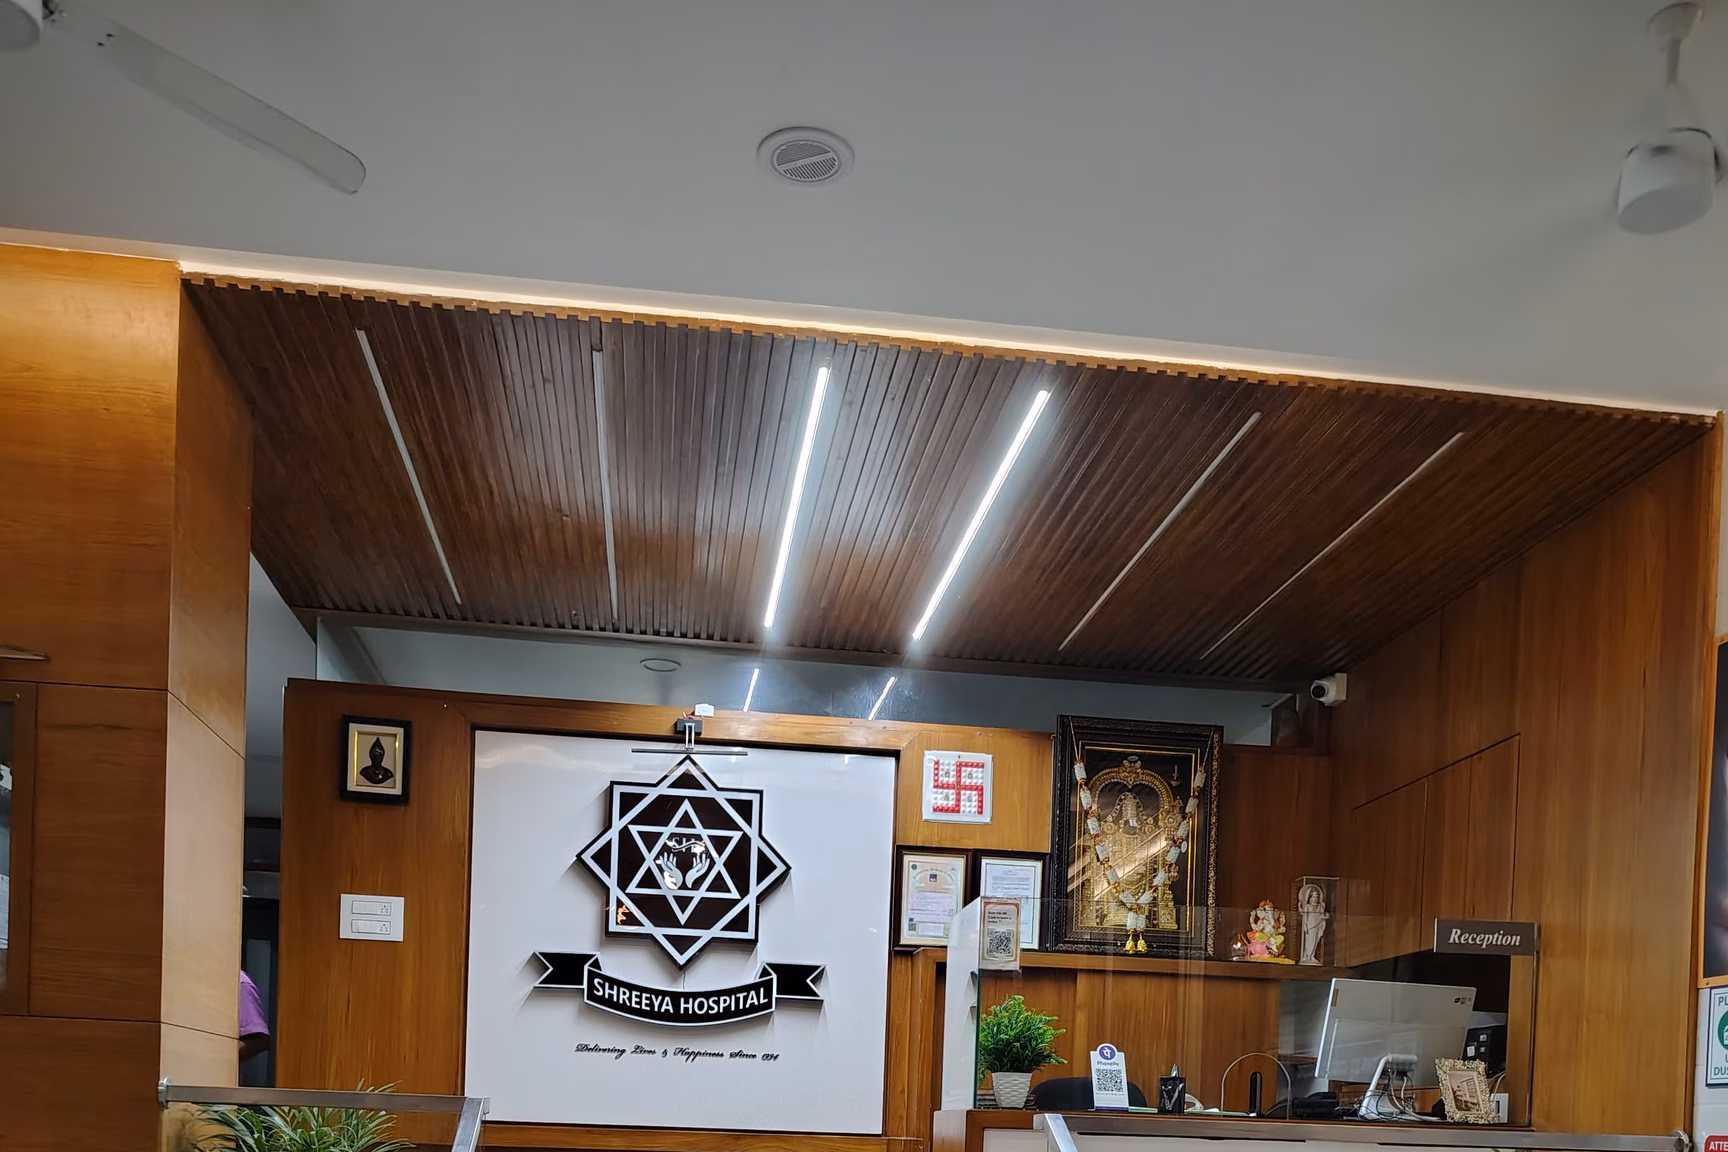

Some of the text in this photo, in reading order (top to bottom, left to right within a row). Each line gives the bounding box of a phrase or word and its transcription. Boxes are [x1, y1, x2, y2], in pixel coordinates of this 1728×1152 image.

[1448, 928, 1520, 949] Reception
[593, 978, 768, 1014] SHREEYA HOSPITAL
[574, 1042, 627, 1060] Delivering
[630, 1044, 657, 1055] Lives
[673, 1047, 724, 1063] Happiness
[729, 1049, 757, 1060] Since
